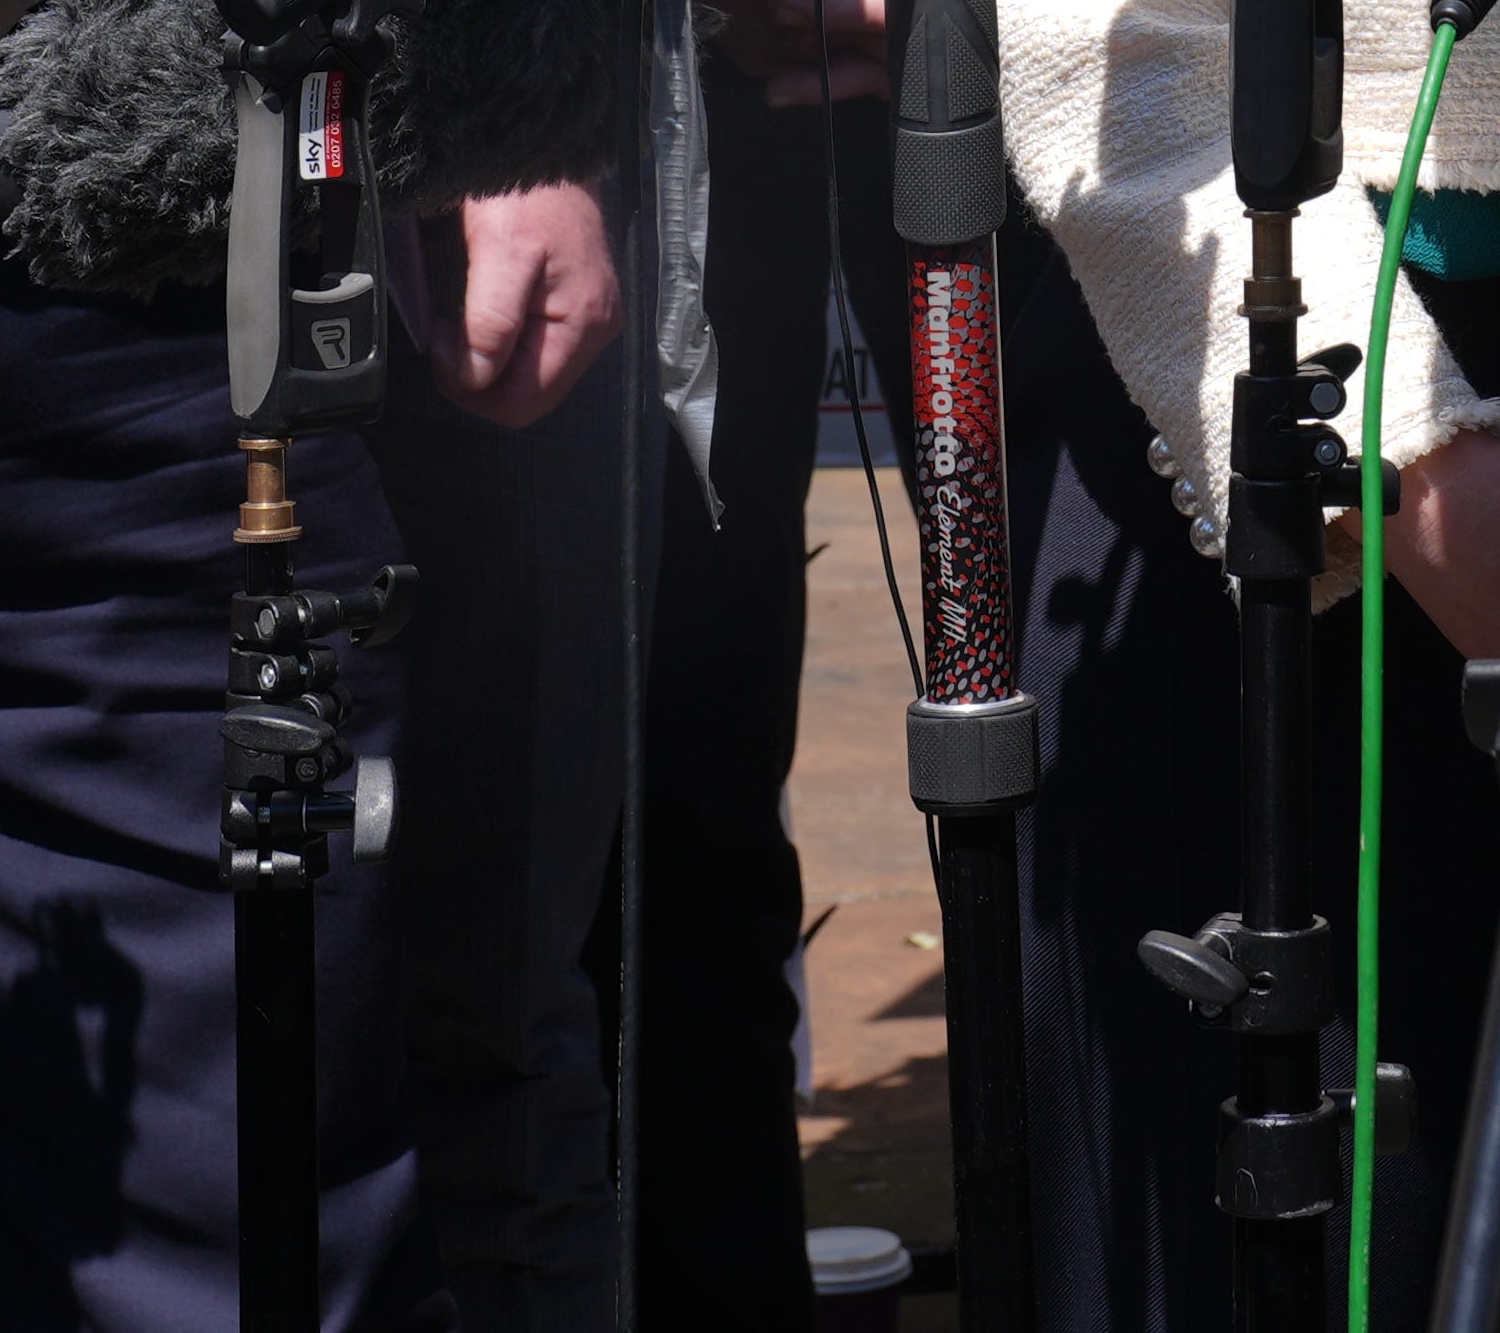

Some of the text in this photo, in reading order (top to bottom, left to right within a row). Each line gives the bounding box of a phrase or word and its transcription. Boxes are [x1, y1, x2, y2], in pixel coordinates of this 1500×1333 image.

[305, 137, 323, 174] sky
[330, 137, 342, 168] 0207
[924, 270, 957, 476] Manfrotto
[936, 485, 962, 593] Element
